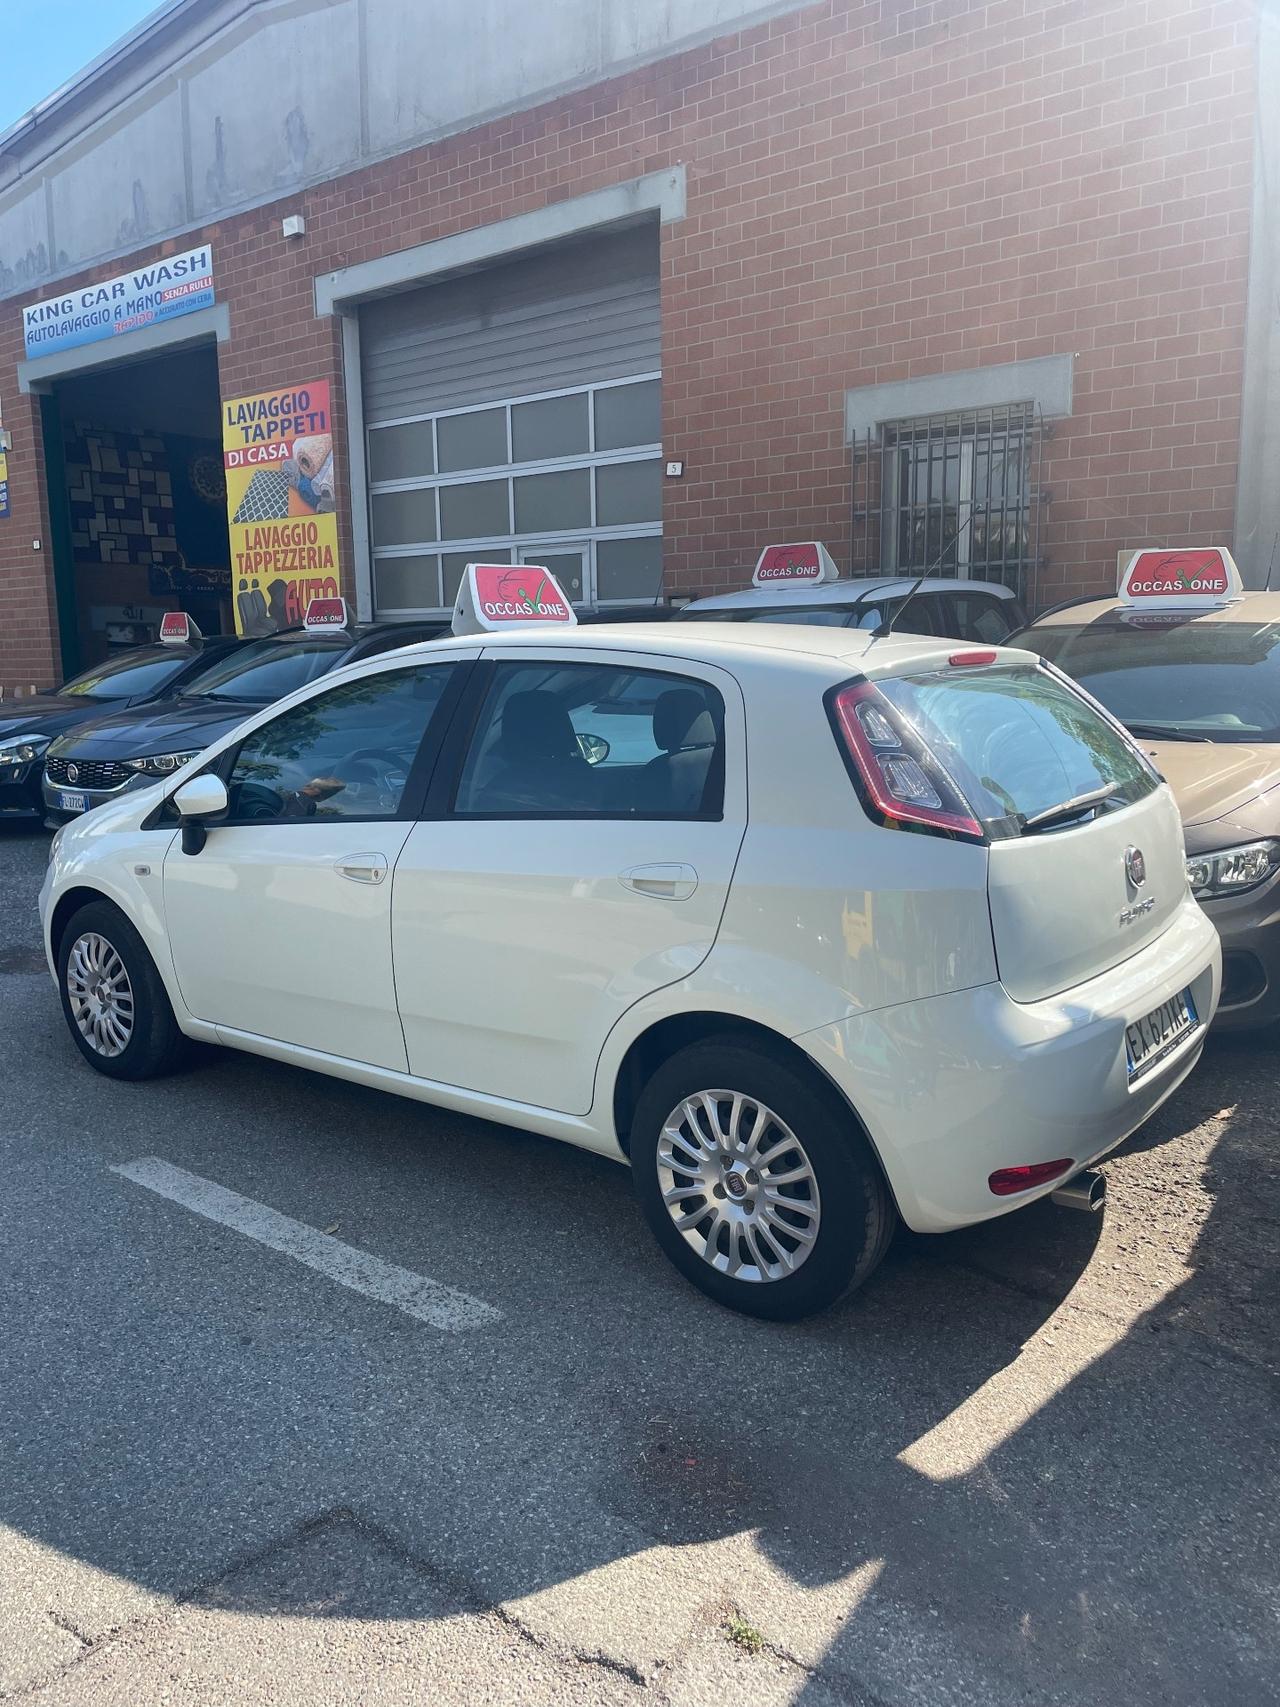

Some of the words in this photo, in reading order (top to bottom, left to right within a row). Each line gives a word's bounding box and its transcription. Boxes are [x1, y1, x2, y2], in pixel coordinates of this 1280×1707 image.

[27, 299, 73, 325] KING
[81, 282, 125, 308] CAR
[133, 252, 207, 290] WASH
[164, 286, 189, 300] SENZA
[189, 277, 212, 292] RULLI
[27, 308, 110, 345] AUTOLAVAGGIO
[114, 304, 123, 320] A
[126, 290, 163, 315] MANO
[227, 390, 310, 426] LAVAGGIO
[241, 410, 326, 444] TAPPETI
[228, 449, 244, 467] DI
[247, 442, 289, 463] CASA
[671, 465, 677, 473] 5
[244, 521, 318, 551] LAVAGGIO
[236, 544, 334, 576] TAPPEZZERIA
[1126, 1019, 1150, 1062] EX
